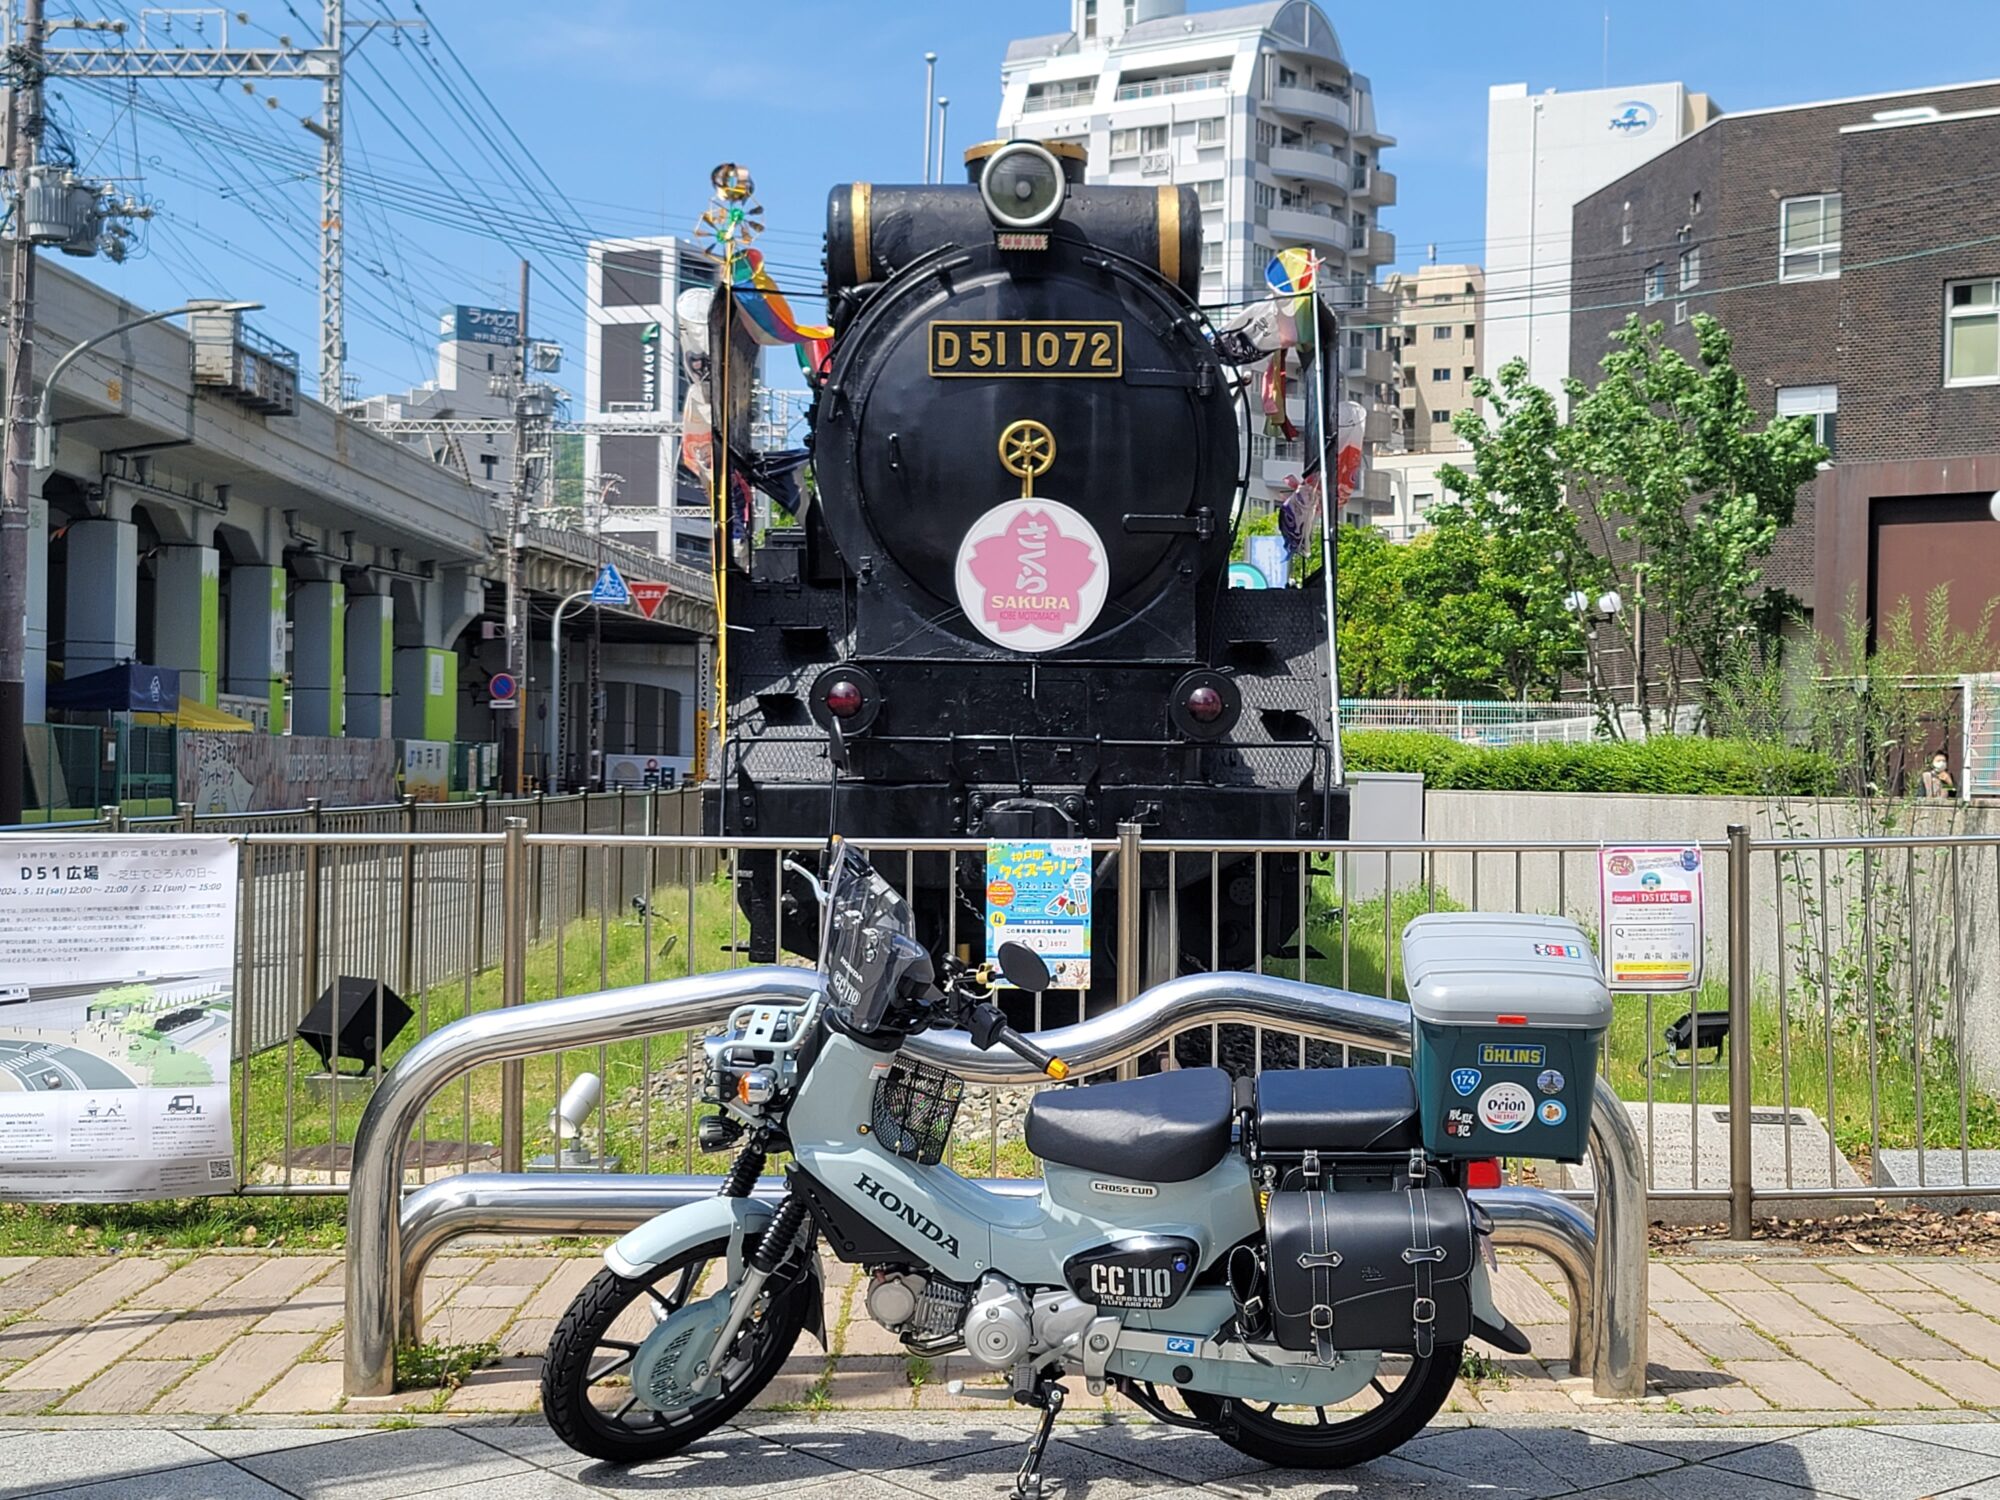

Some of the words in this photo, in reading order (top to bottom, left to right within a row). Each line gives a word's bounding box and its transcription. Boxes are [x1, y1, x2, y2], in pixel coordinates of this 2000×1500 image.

[1021, 331, 1112, 367] 1072
[1016, 521, 1049, 594] さくら
[991, 595, 1070, 610] SAKURA
[1000, 611, 1016, 620] KOBE
[1019, 611, 1060, 621] MOTOMACHI
[21, 865, 99, 880] D51広場
[1615, 928, 1624, 938] Q
[840, 956, 863, 983] HONDA
[1483, 1045, 1541, 1063] ÖHLINS
[1456, 1075, 1475, 1085] 174
[1487, 1097, 1526, 1111] Orion
[1094, 1183, 1129, 1193] CROSS
[854, 1172, 959, 1259] HONDA
[1116, 1295, 1163, 1303] CROSSOVER
